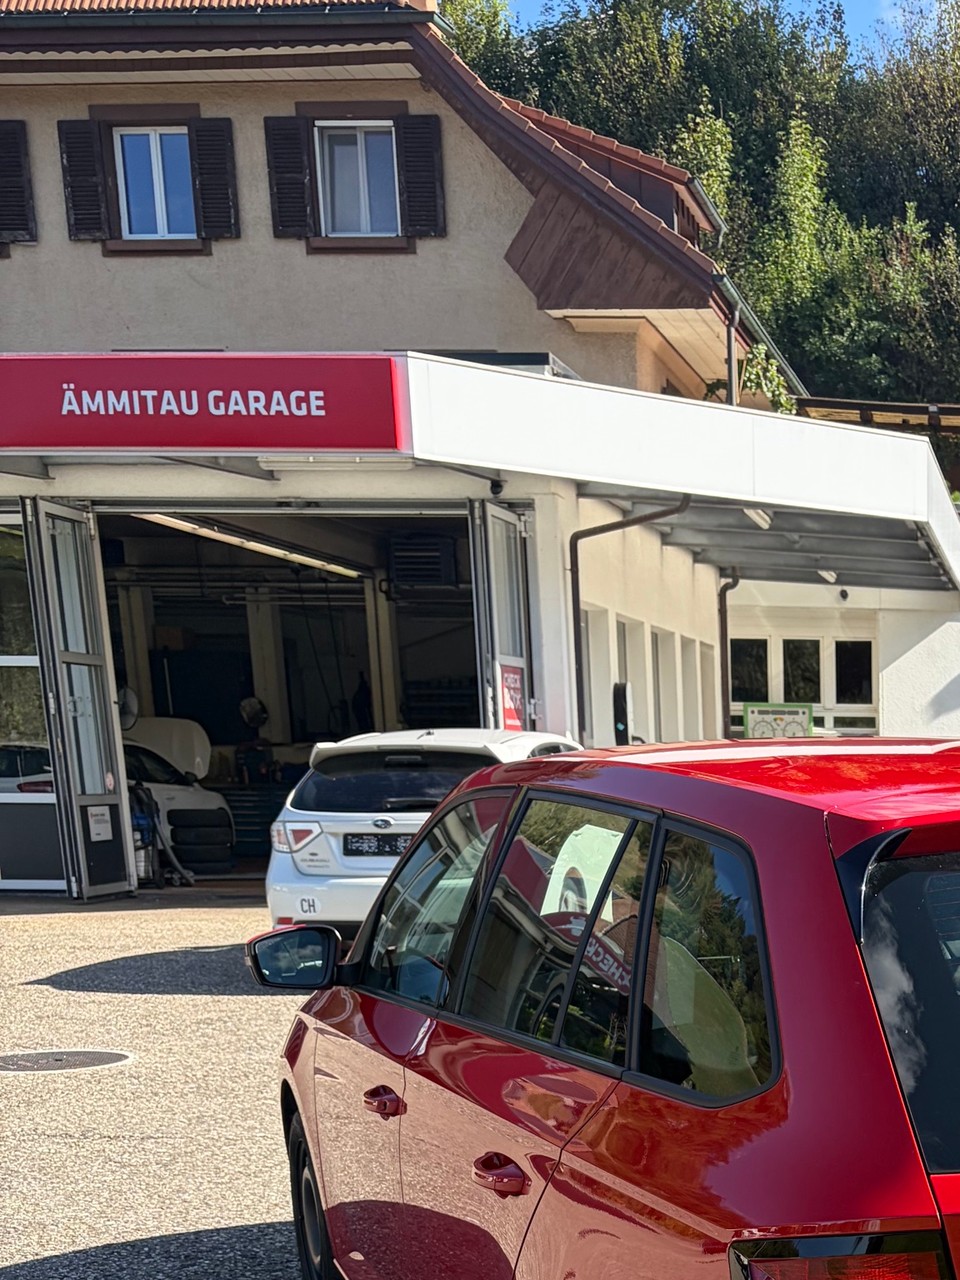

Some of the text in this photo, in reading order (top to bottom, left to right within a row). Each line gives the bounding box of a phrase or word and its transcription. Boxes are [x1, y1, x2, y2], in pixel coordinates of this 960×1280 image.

[62, 383, 326, 416] ÄMMITAU GARAGE
[300, 898, 316, 914] CH
